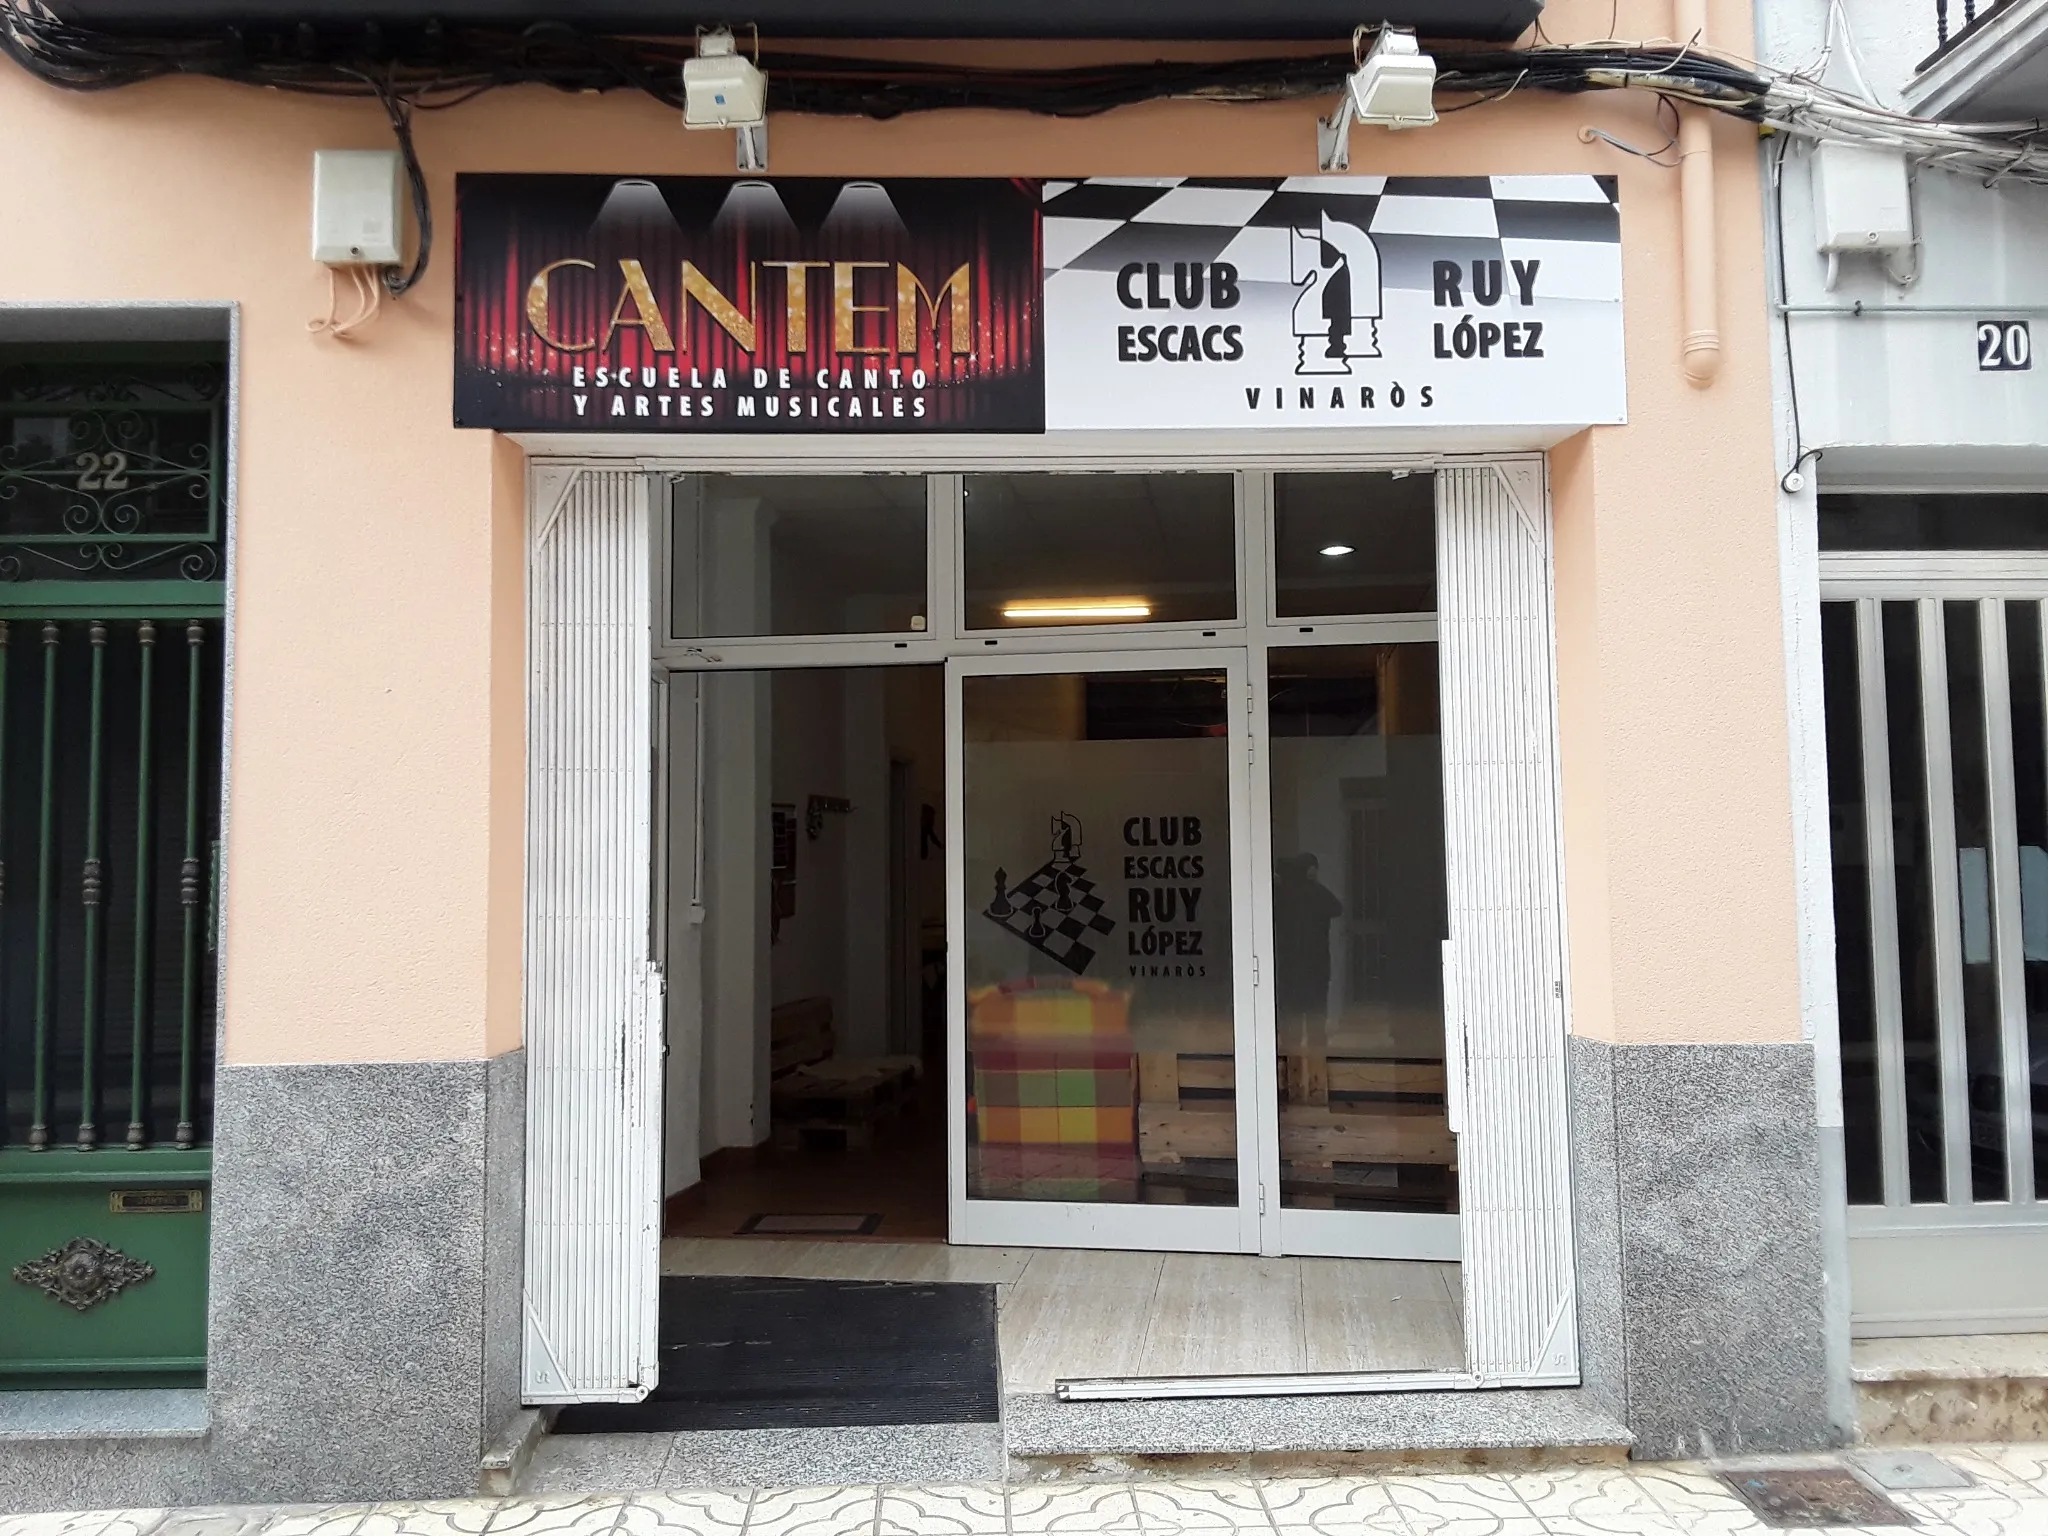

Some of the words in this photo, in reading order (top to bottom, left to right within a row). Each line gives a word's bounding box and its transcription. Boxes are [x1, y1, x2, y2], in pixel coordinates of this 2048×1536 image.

[1116, 261, 1240, 309] CLUB
[1432, 259, 1541, 307] RUY
[526, 257, 973, 354] CANTEM
[1117, 325, 1244, 362] ESCACS
[1433, 315, 1544, 359] LÓPEZ
[1978, 323, 2029, 367] 20
[573, 367, 727, 389] ESCUELA
[753, 368, 791, 389] DE
[816, 368, 926, 390] CANTO
[1245, 382, 1434, 410] VINARÒS
[573, 394, 588, 416] Y
[610, 395, 714, 417] ARTES
[737, 396, 926, 418] MUSICALES
[76, 451, 129, 490] 22
[1122, 816, 1202, 846] CLUB
[1123, 855, 1204, 879] ESCACS
[1128, 887, 1202, 922] RUY
[1128, 925, 1203, 956] LÓPEZ
[1129, 962, 1206, 978] VINARÒS
